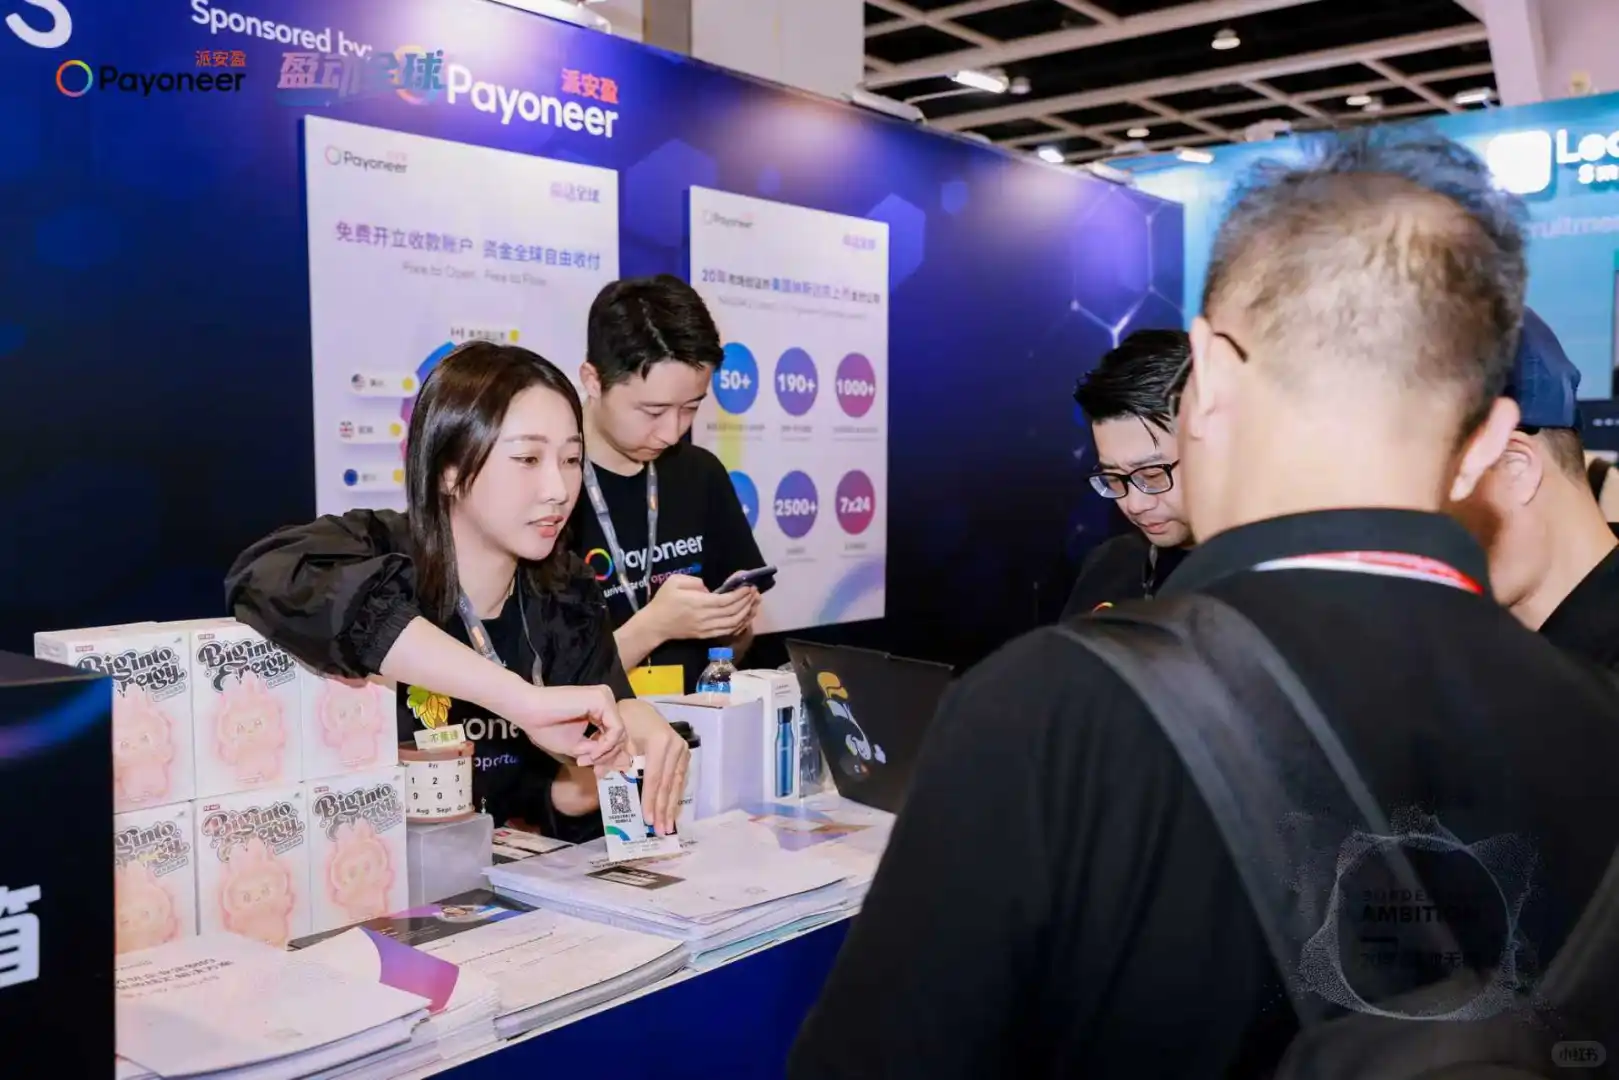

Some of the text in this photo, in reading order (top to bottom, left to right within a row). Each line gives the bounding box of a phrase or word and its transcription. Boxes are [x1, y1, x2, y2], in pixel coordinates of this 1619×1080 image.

[191, 0, 331, 53] Sponsored
[562, 68, 618, 104] 派安盈
[447, 64, 619, 138] Payoneer
[720, 370, 751, 389] 50+
[777, 374, 815, 393] 190+
[836, 378, 875, 397] 1000+
[774, 498, 818, 516] 2500+
[618, 535, 703, 570] ayoneer
